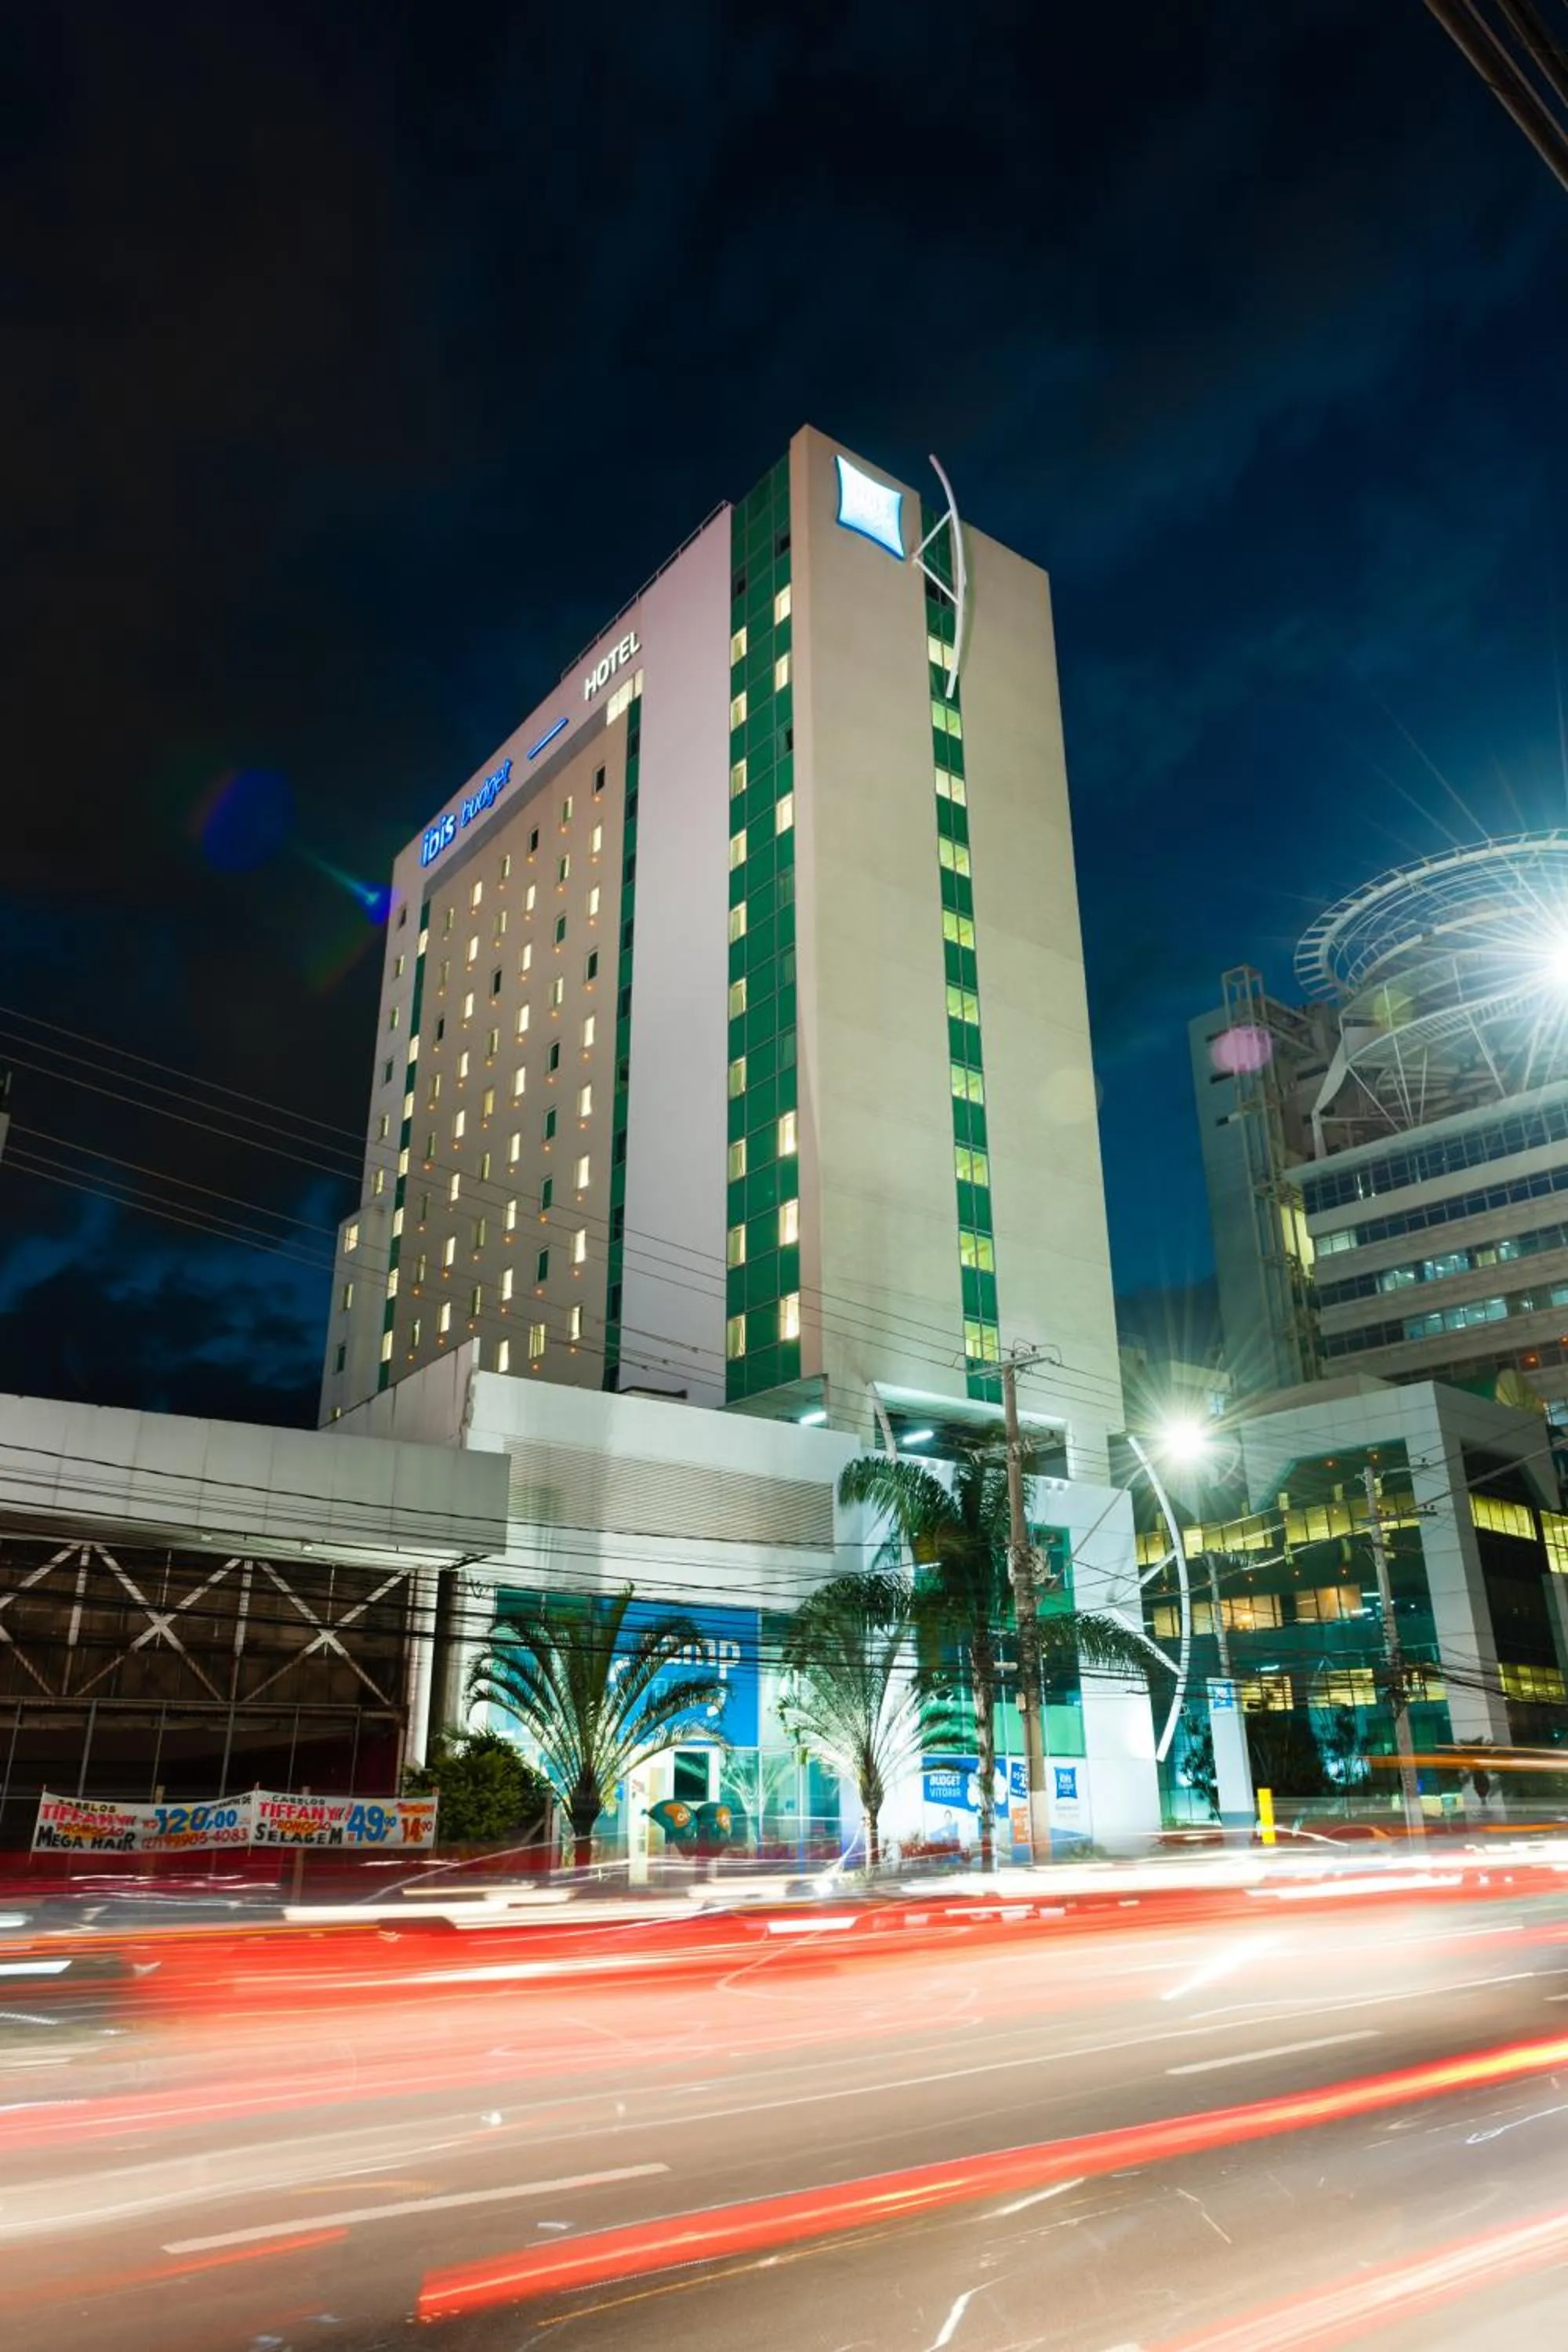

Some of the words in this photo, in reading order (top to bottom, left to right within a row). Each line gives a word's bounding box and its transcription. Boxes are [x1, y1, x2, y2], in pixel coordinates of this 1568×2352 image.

[585, 632, 641, 701] HOTEL
[421, 812, 456, 867] ibis
[460, 758, 512, 828] budget
[154, 1806, 238, 1835] 120,00
[255, 1823, 343, 1845] SELAGEM
[36, 1824, 84, 1848] MEGA
[91, 1831, 136, 1851] HAIR
